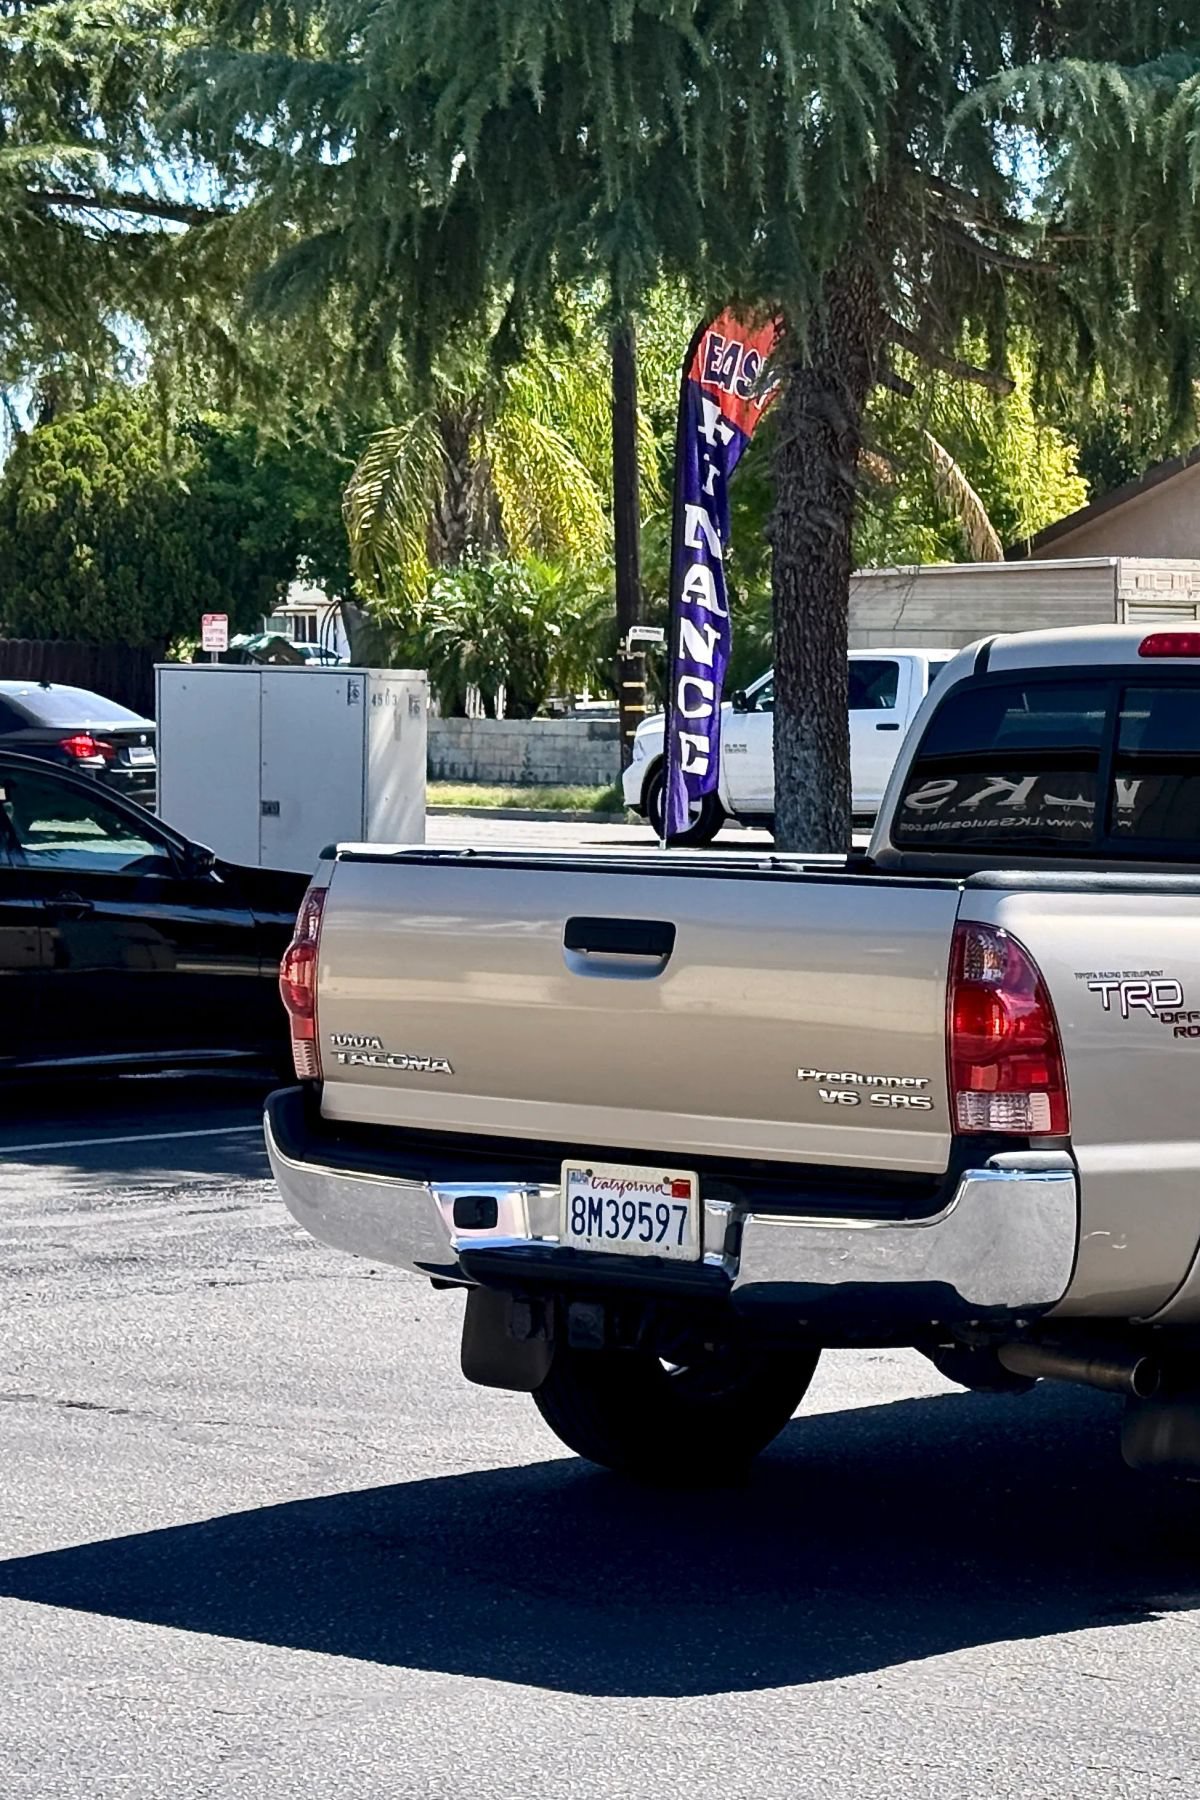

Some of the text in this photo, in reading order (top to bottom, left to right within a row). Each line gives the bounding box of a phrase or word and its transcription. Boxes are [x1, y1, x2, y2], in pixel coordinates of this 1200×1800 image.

[1087, 978, 1184, 1020] TRD
[1160, 1010, 1200, 1025] OFF
[331, 1050, 455, 1075] TACOMA
[797, 1067, 932, 1090] PreRunner
[818, 1088, 861, 1107] V6
[591, 1176, 672, 1199] California
[570, 1195, 689, 1246] 8M39597
